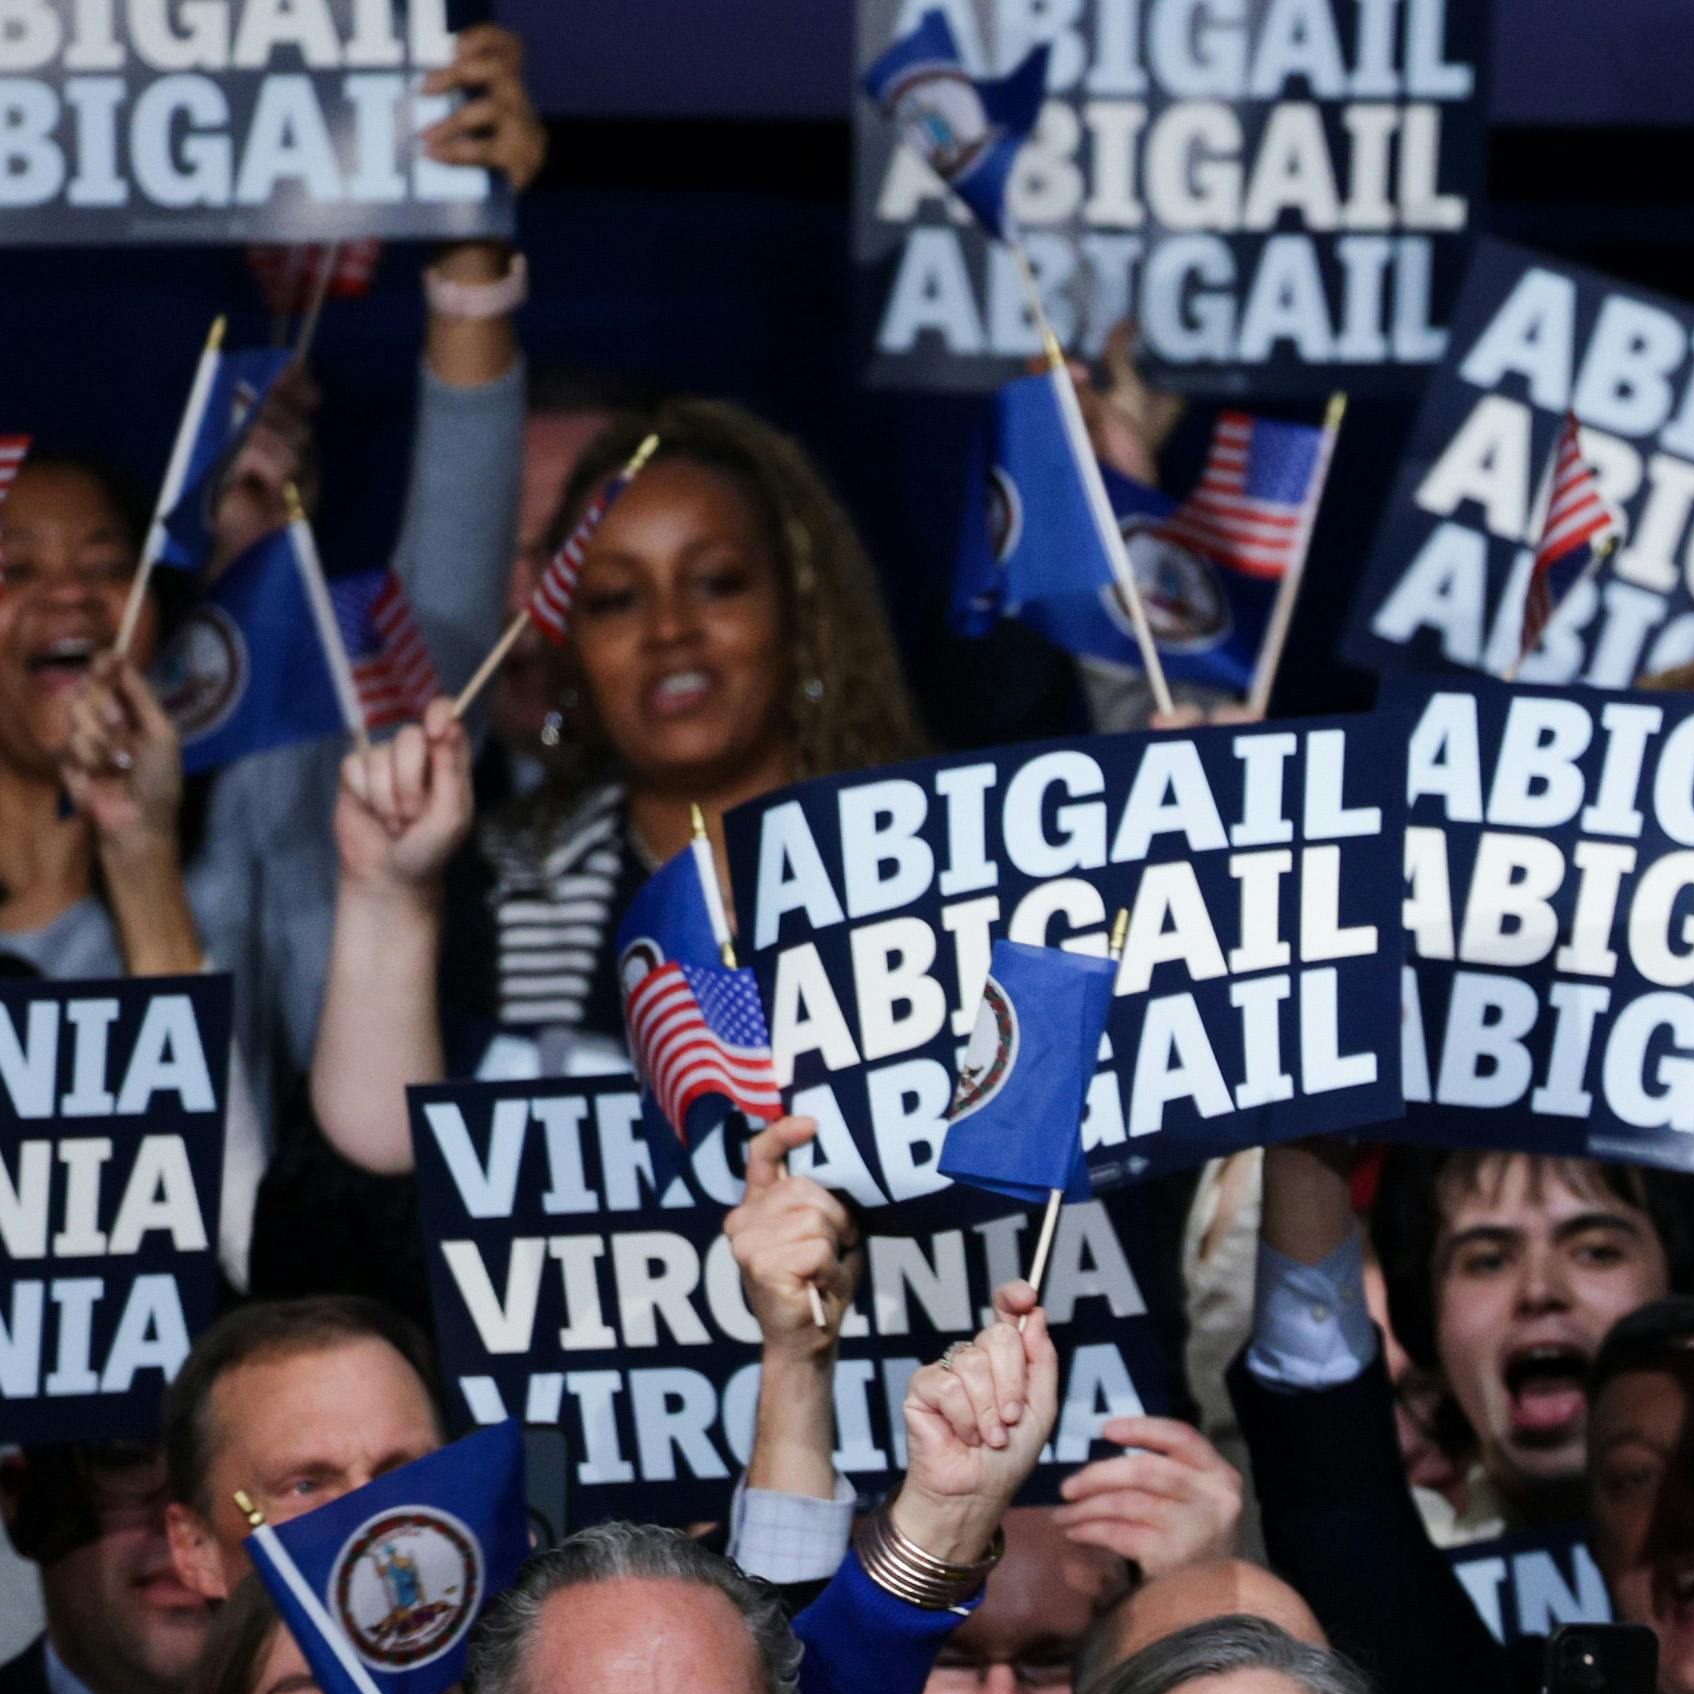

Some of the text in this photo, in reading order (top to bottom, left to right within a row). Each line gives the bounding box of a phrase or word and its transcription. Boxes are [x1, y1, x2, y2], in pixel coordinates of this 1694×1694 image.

[0, 0, 460, 68] BIGAIL
[0, 73, 490, 209] BIGAIL
[878, 228, 1450, 363] ABIGAIL
[755, 729, 1381, 951] ABIGAIL
[788, 966, 1378, 1207] ABAIL
